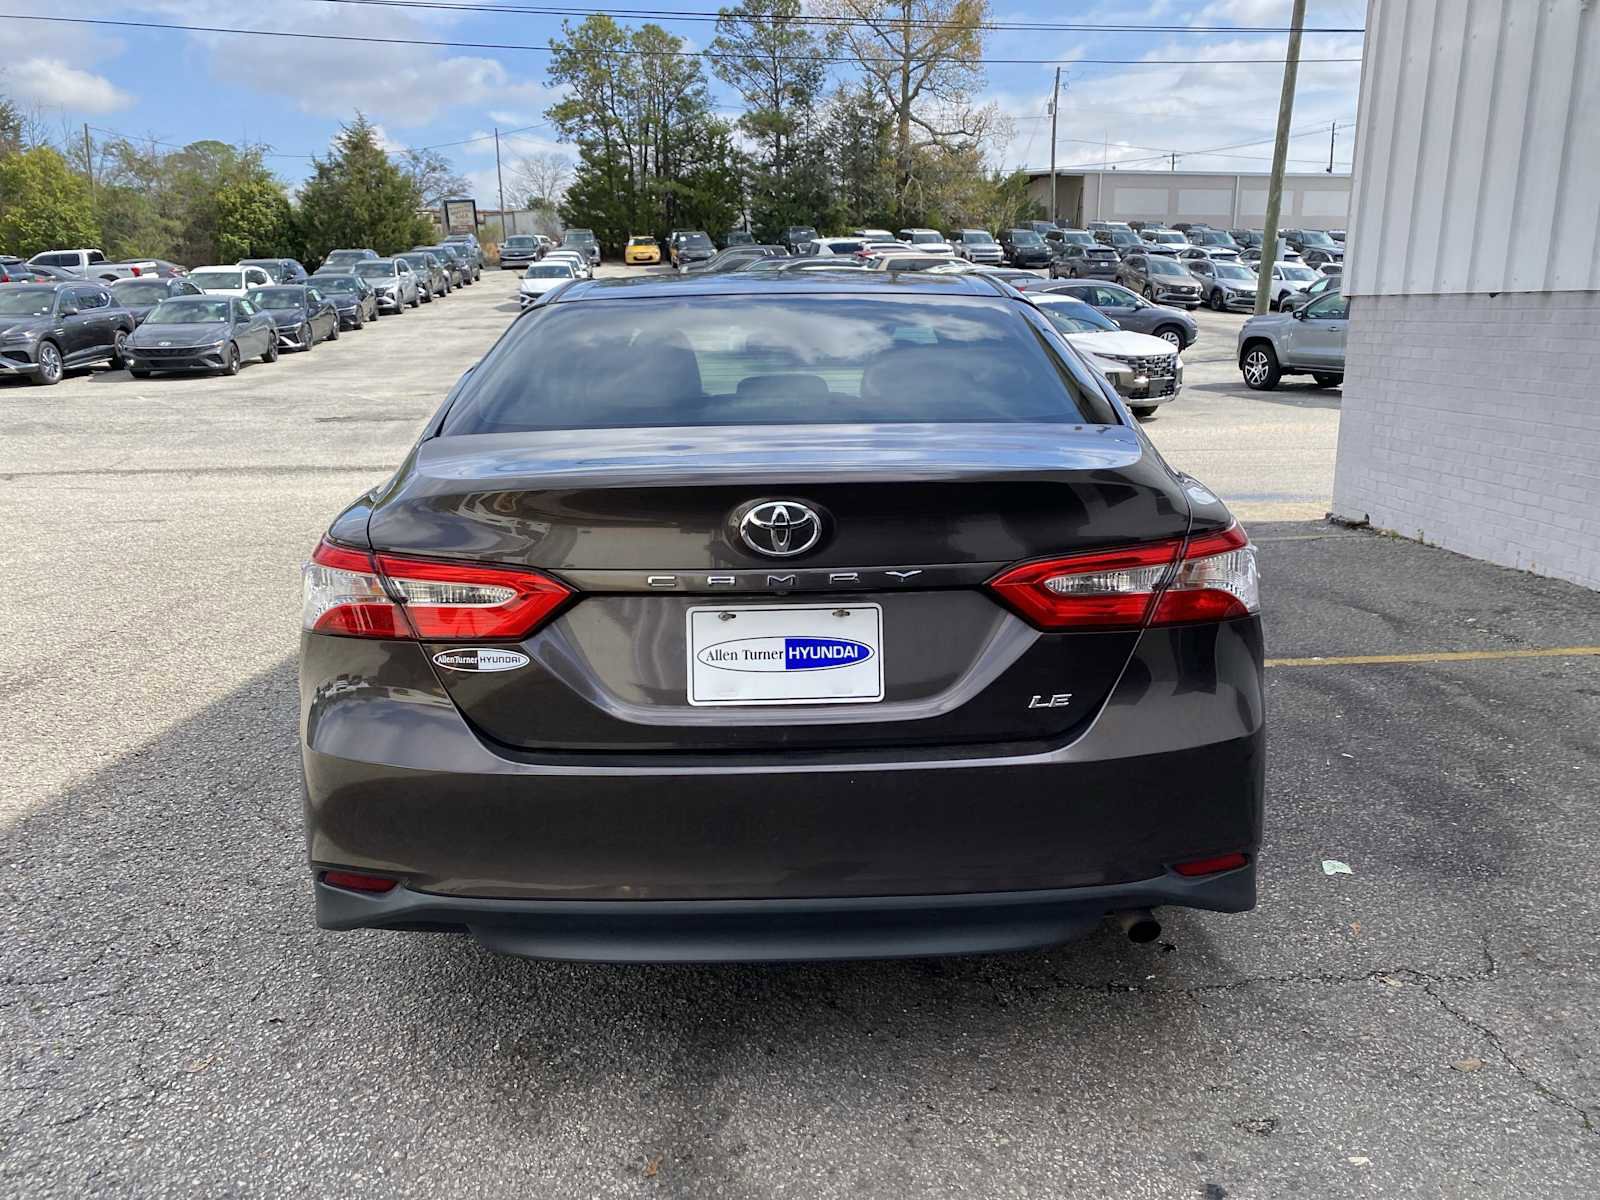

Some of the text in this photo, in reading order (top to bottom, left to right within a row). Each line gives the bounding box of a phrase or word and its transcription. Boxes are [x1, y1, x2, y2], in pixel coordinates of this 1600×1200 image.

[648, 569, 923, 587] CAMRY
[479, 656, 520, 664] HYUNDAI
[706, 645, 858, 662] Allen Turner HYUNDAI
[1028, 693, 1072, 709] LE
